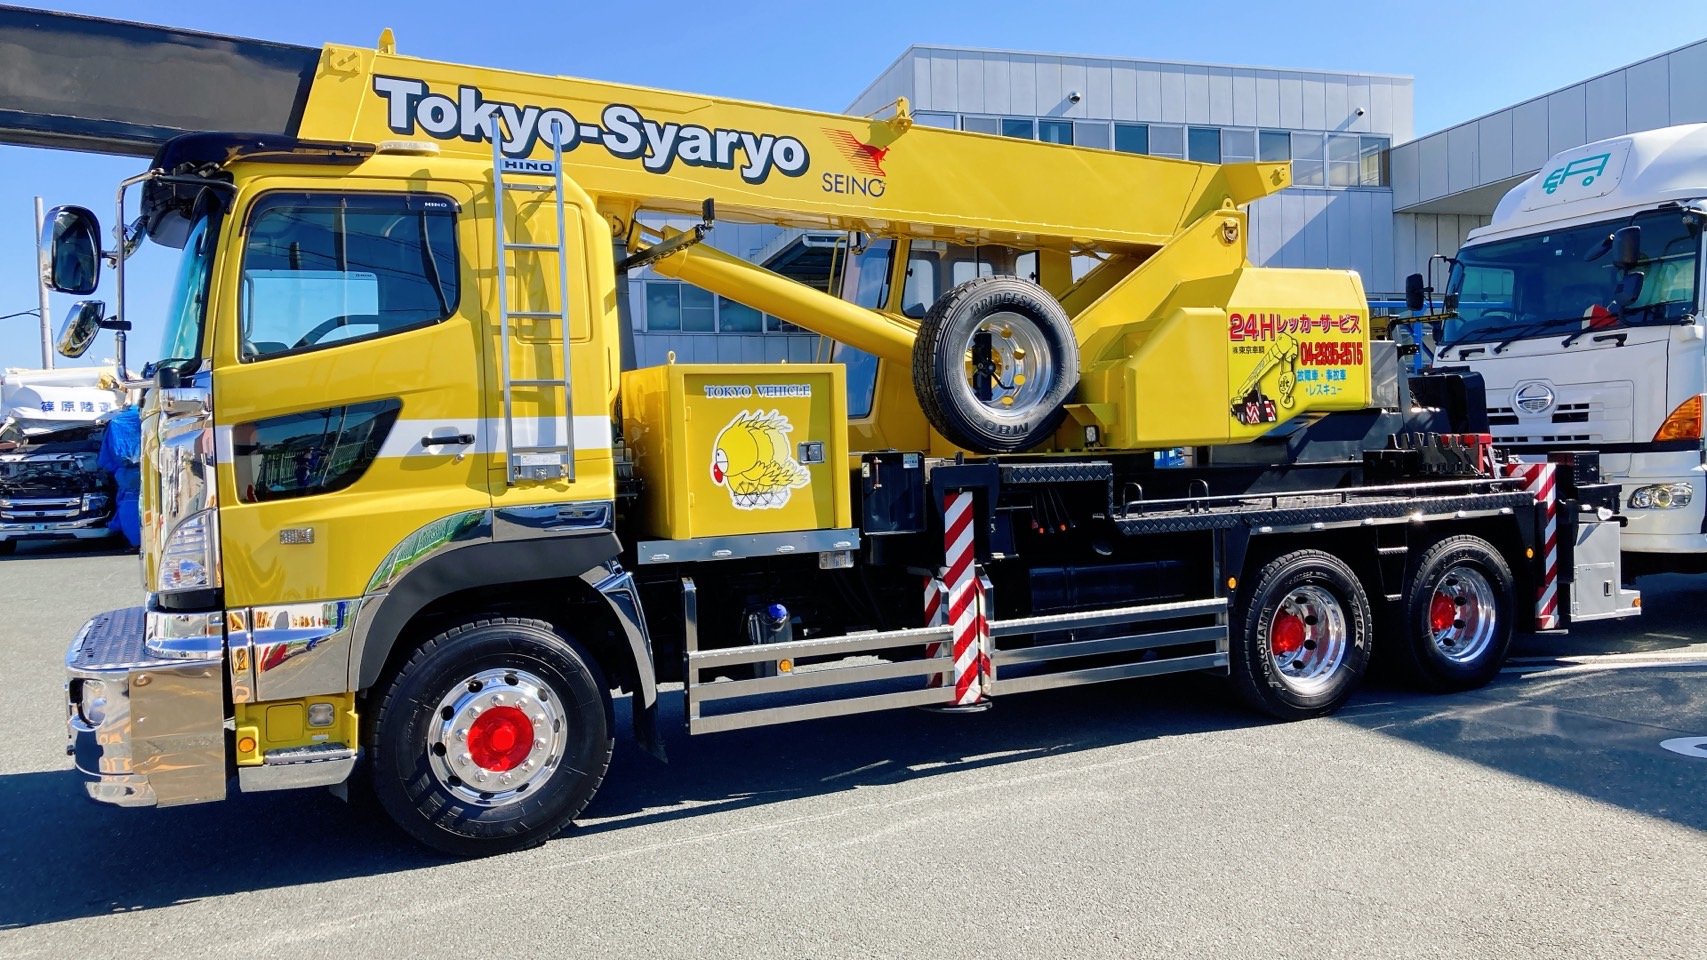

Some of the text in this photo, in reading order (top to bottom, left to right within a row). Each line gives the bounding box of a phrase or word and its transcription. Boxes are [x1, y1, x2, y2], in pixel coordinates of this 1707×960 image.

[373, 74, 810, 185] Tokyo-Syaryo
[504, 160, 553, 172] HINO
[822, 172, 886, 198] SEINO
[705, 384, 810, 398] TOKYO VEHICLE
